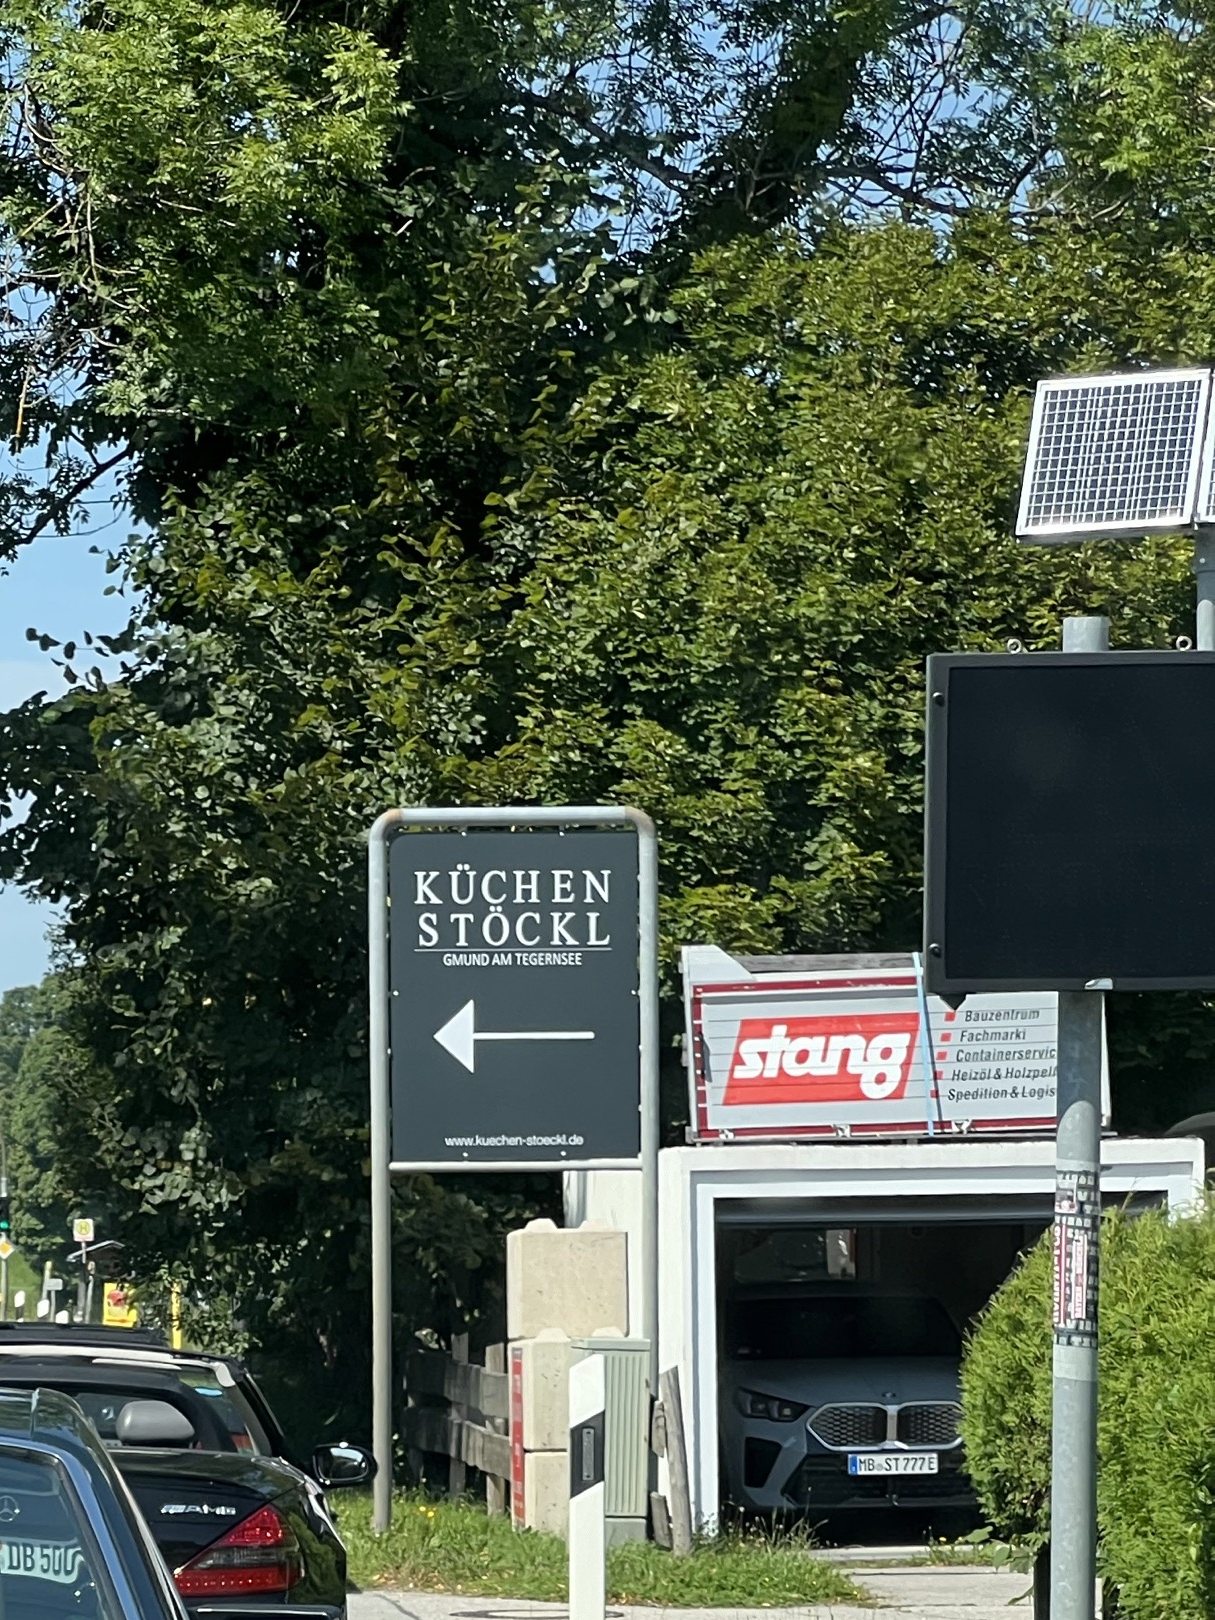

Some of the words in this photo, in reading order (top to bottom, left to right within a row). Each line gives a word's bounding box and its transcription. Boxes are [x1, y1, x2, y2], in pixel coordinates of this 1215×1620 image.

[413, 863, 612, 905] KÜCHEN
[418, 906, 612, 947] STÖCKL
[443, 953, 490, 967] GMUND
[492, 953, 513, 967] AM
[515, 952, 583, 967] TEGERNSEE
[965, 1009, 1040, 1022] Bauzentrum
[733, 1024, 911, 1099] stang
[956, 1046, 1056, 1062] Containerservic
[951, 1068, 991, 1081] Heizöl
[993, 1067, 1002, 1080] &
[1010, 1087, 1020, 1099] &
[1021, 1085, 1056, 1100] Logis
[444, 1133, 585, 1147] www.kuechen-stoeckl.de
[858, 1458, 875, 1471] MB
[884, 1457, 900, 1471] ST
[7, 1541, 35, 1572] DB
